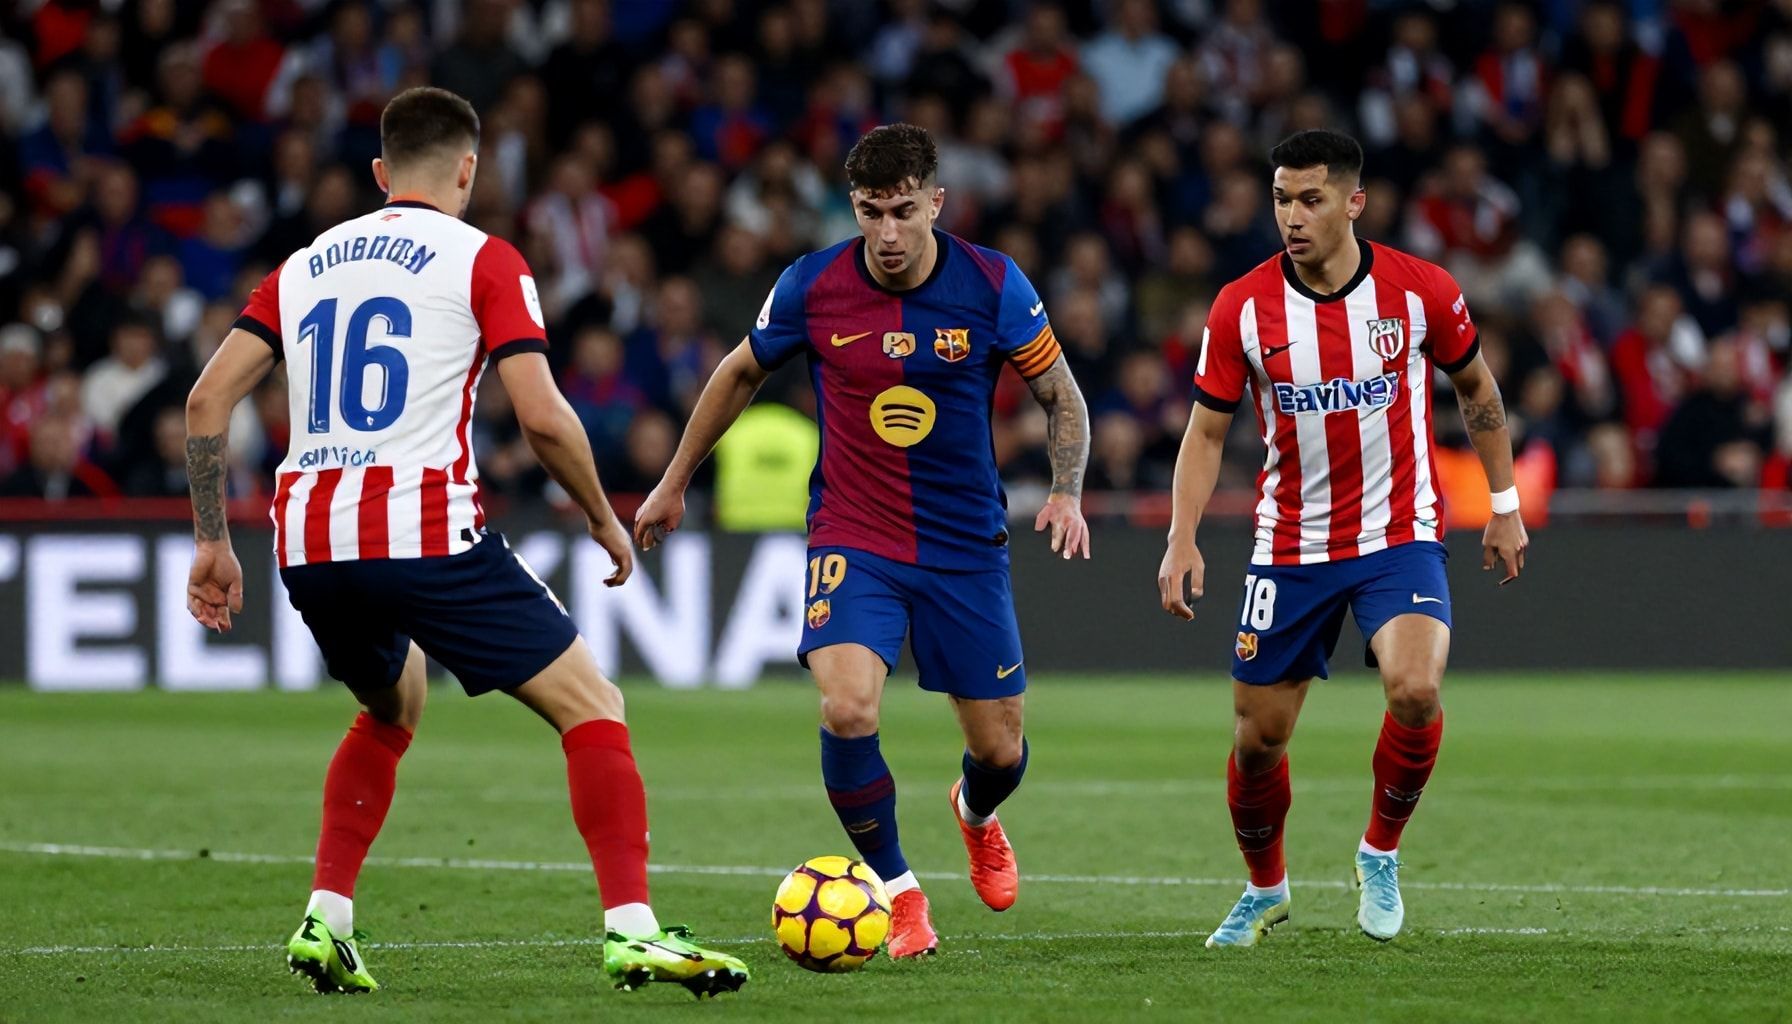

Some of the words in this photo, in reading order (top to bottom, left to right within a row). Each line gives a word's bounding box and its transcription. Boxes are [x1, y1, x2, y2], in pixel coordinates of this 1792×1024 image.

[297, 296, 413, 434] 16
[808, 553, 848, 599] 19
[1240, 573, 1277, 631] 18
